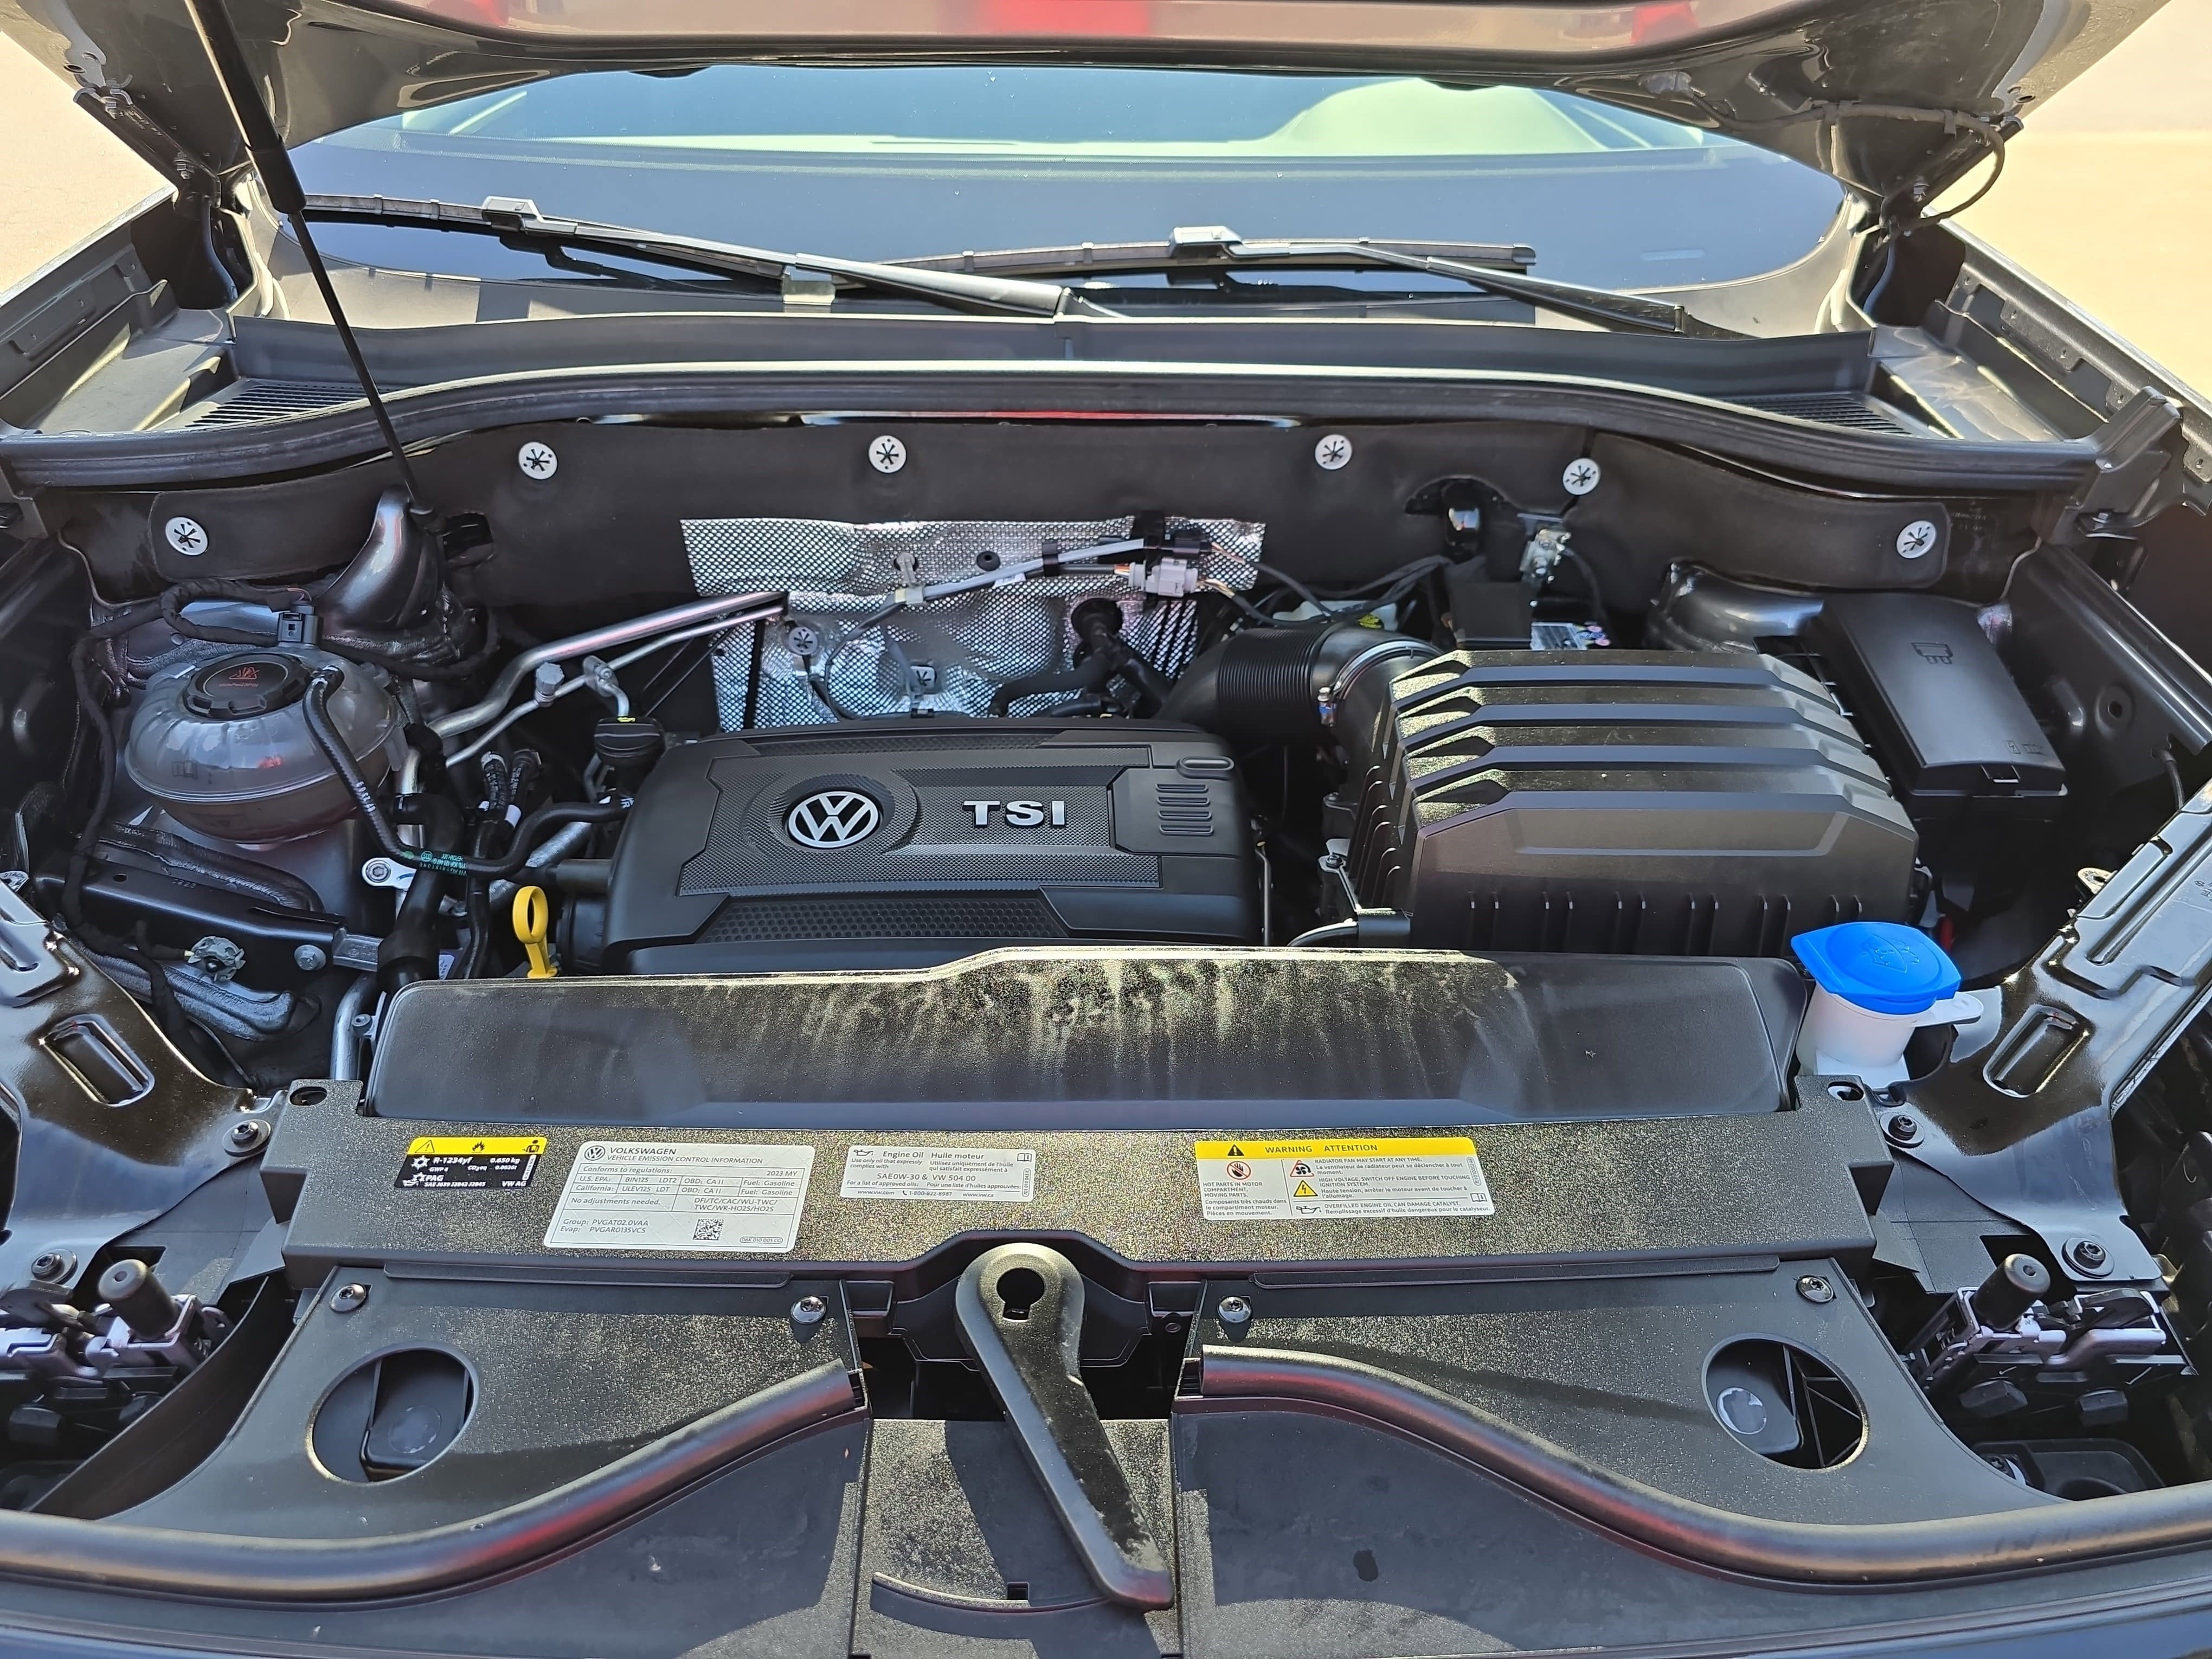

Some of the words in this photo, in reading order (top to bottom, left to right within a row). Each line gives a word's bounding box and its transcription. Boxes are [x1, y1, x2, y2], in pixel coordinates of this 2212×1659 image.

[792, 792, 876, 847] VW
[963, 801, 1066, 826] TSI
[433, 1157, 473, 1165] R-1234yf
